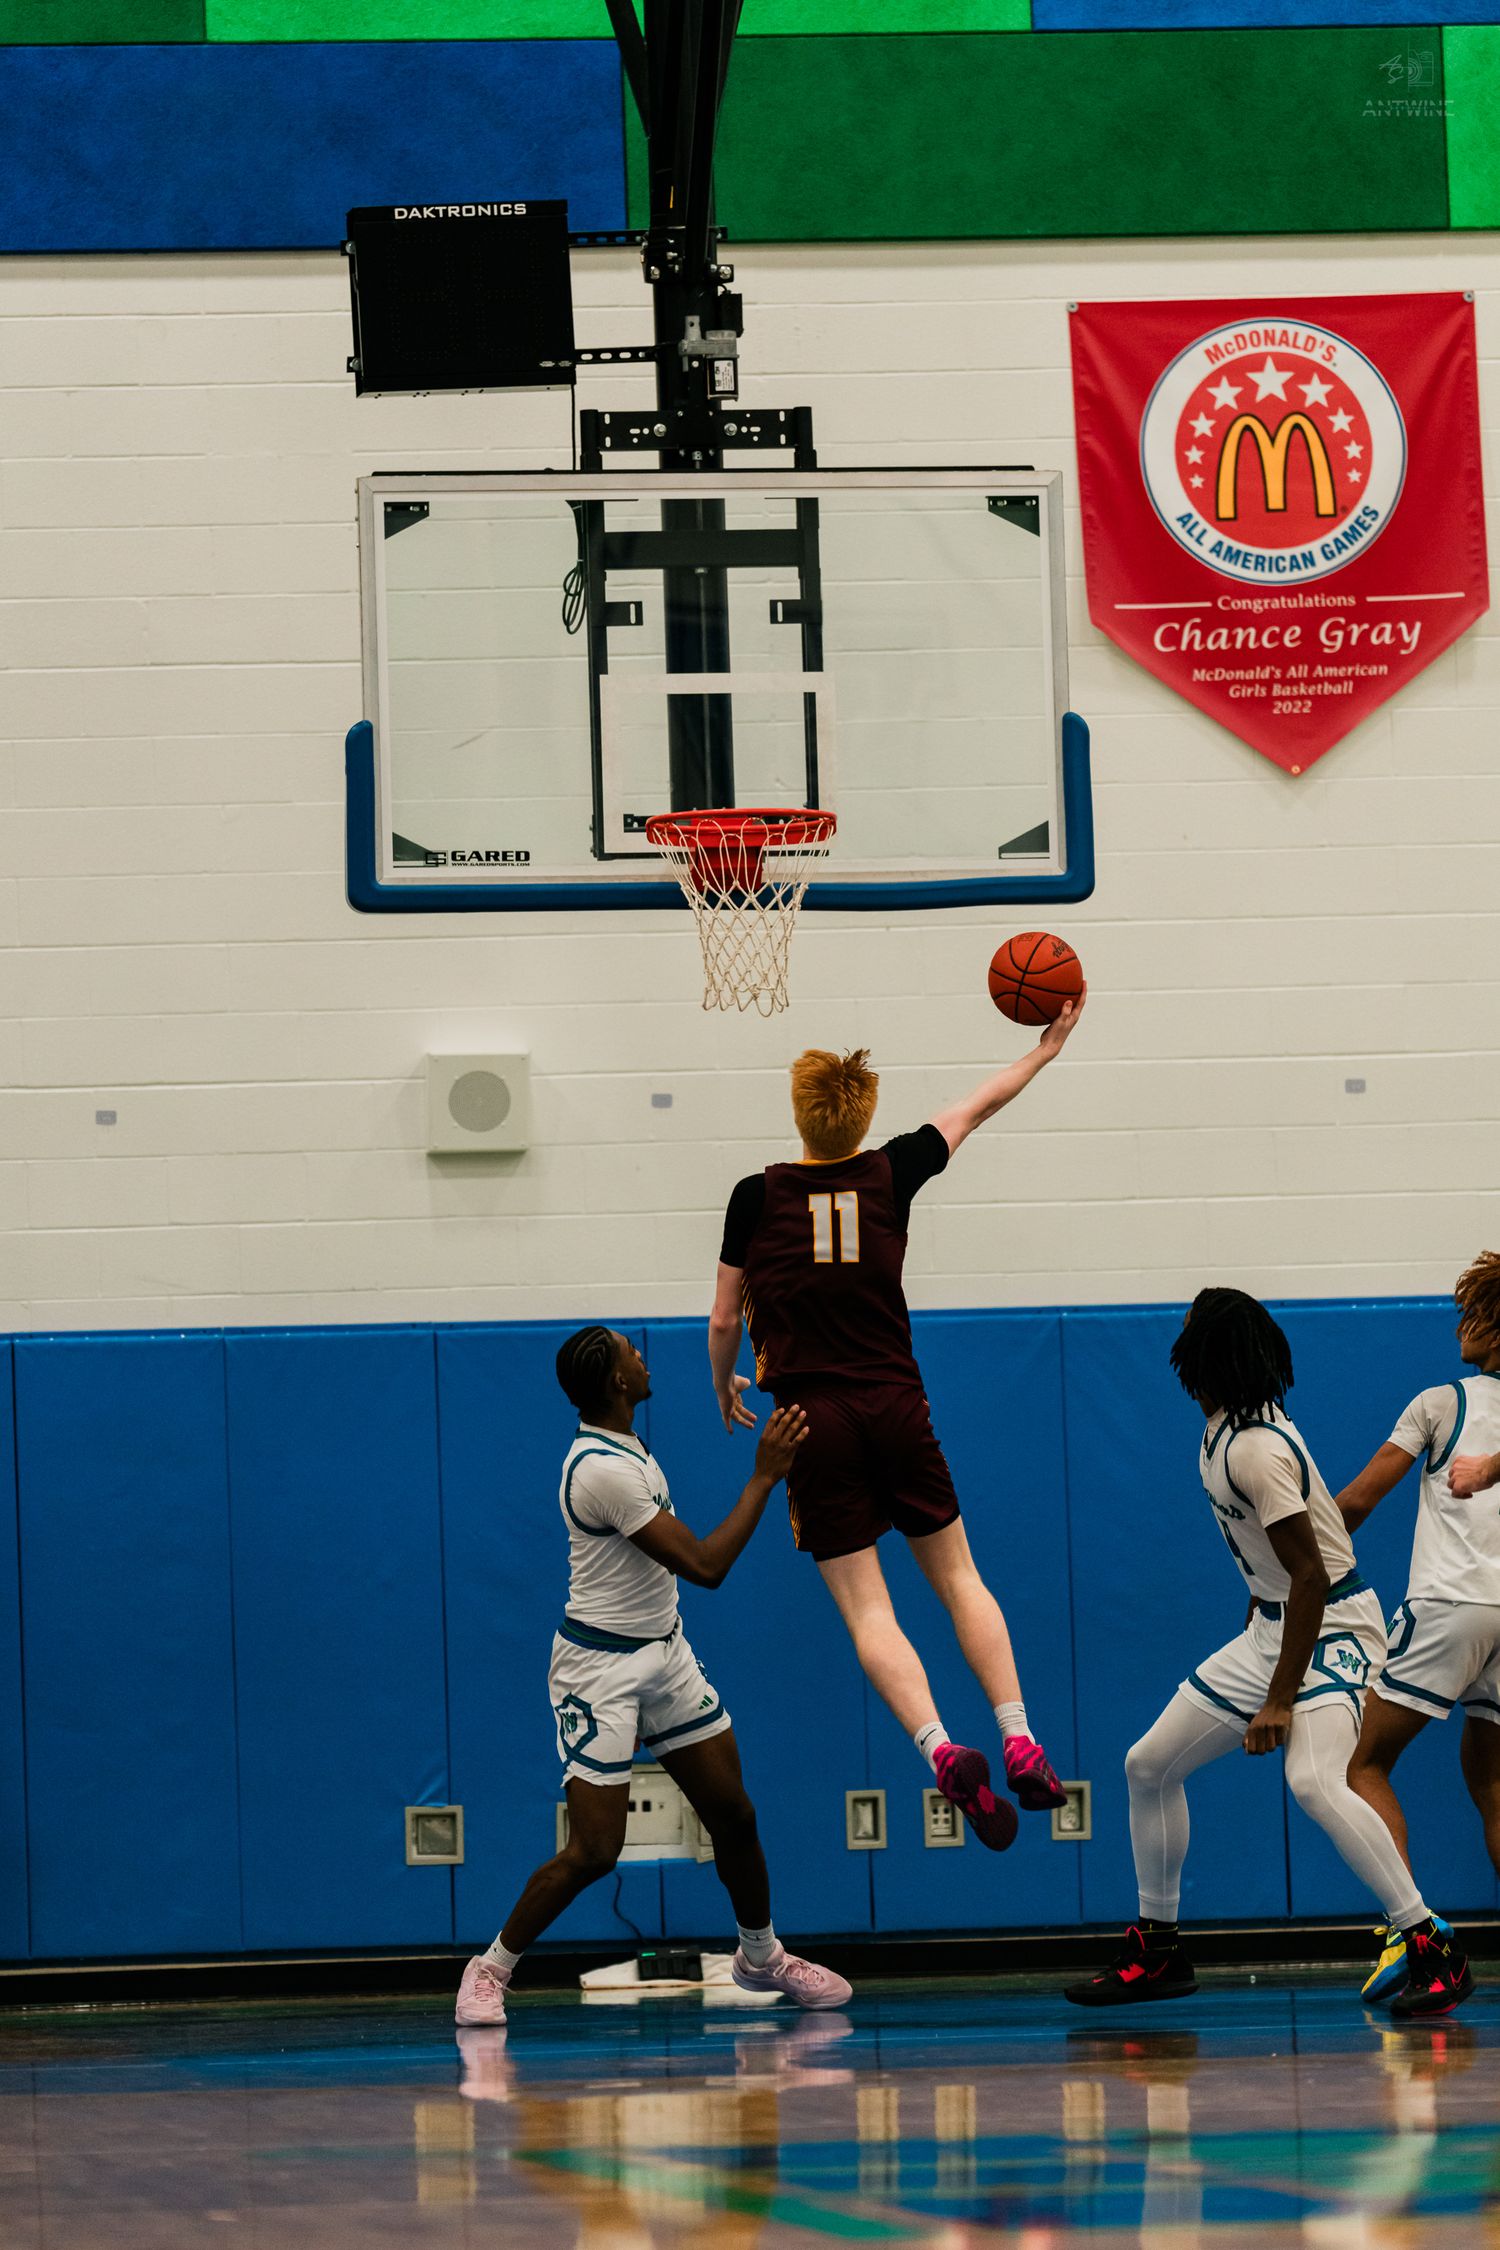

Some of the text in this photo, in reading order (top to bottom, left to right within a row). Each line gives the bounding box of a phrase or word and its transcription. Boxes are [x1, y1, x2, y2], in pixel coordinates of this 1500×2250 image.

[394, 203, 527, 220] DAKTRONICS
[1204, 328, 1335, 365] McDONALD'S
[1175, 505, 1380, 574] ALL AMERICAN GAMES
[1217, 594, 1356, 614] Congratulations
[1153, 616, 1421, 655] Chance Gray
[1192, 663, 1388, 682] McDonald's All American
[1229, 681, 1353, 699] Girls Basketball
[1273, 700, 1312, 715] 2022
[451, 850, 531, 862] GARED
[808, 1191, 859, 1263] 11
